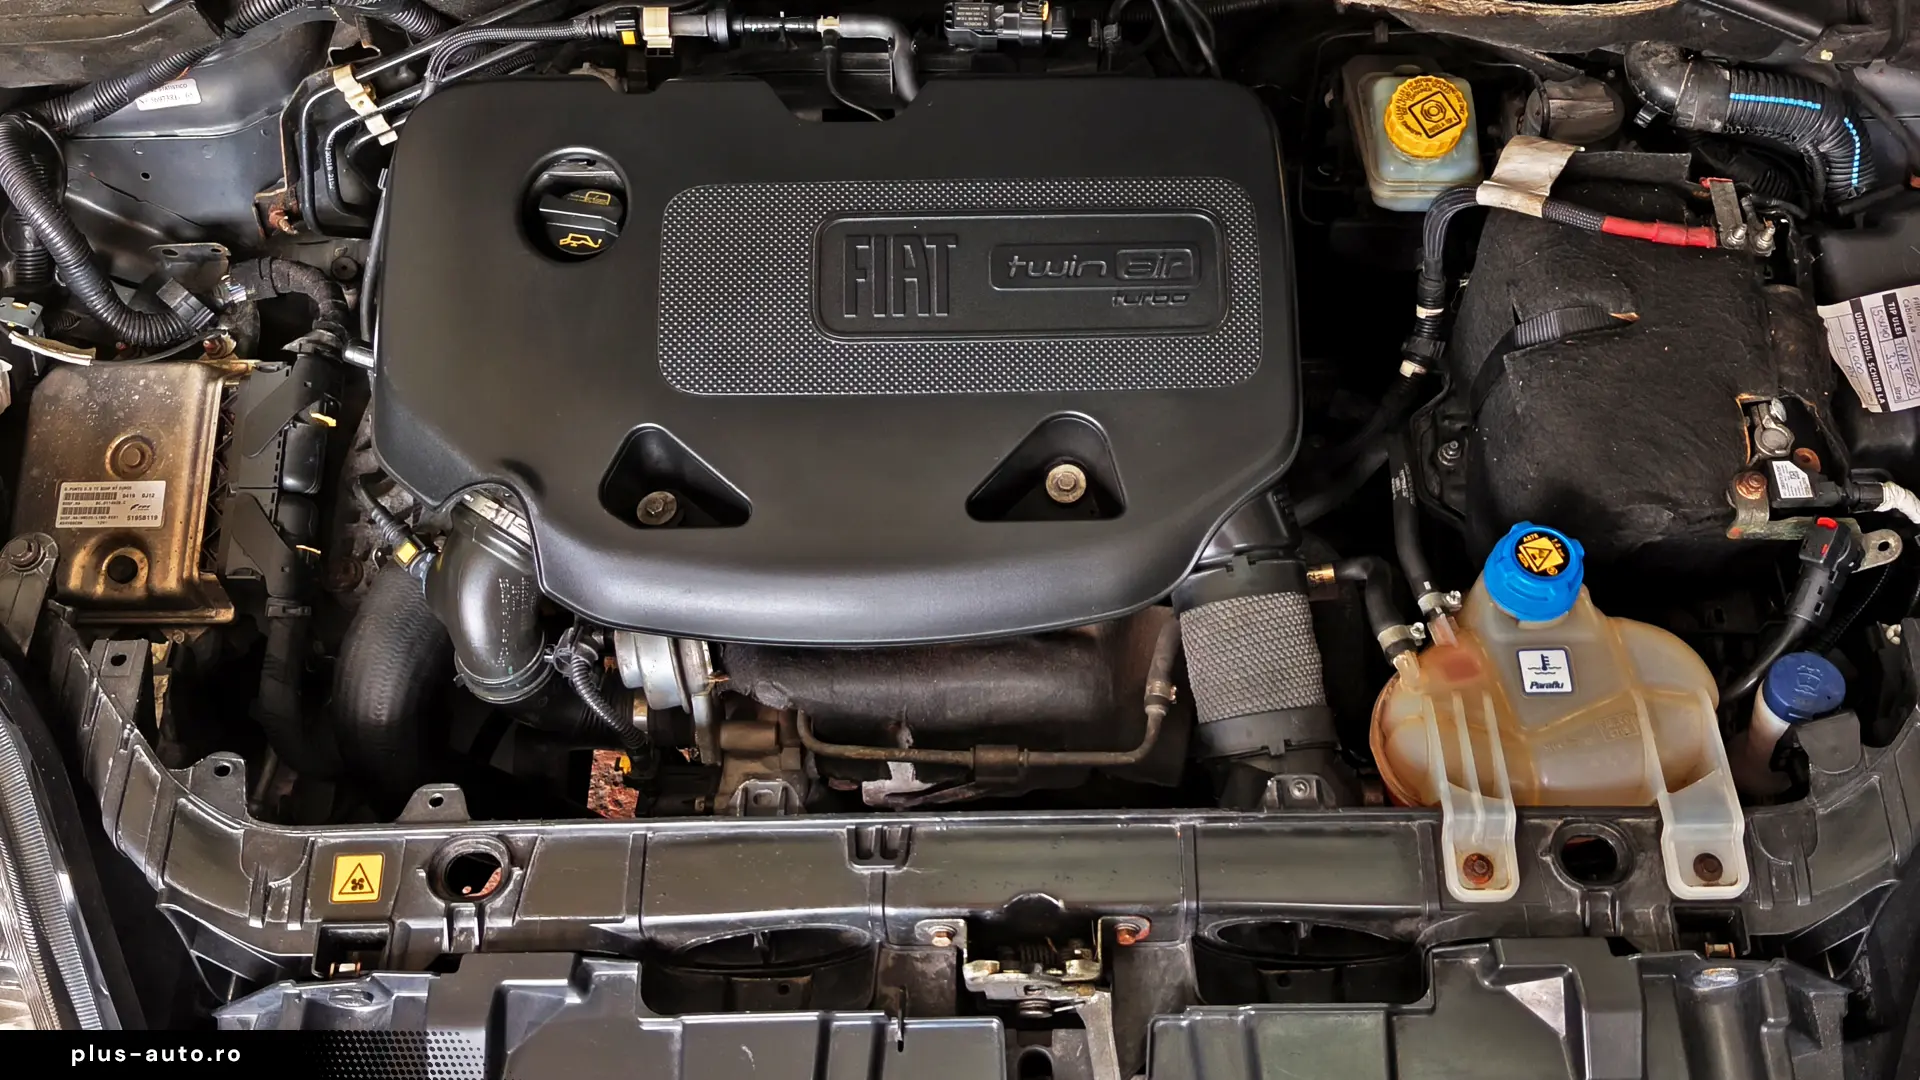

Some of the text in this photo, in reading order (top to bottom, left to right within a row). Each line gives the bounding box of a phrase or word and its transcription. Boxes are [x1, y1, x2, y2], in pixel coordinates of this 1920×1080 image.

[844, 234, 958, 318] FIAT
[1008, 253, 1184, 279] twin air
[1111, 293, 1188, 307] turbo
[1887, 301, 1903, 335] TIP ULEI
[1868, 362, 1881, 392] SCHIMB
[1877, 394, 1886, 404] LA
[1530, 681, 1564, 690] Paraflu
